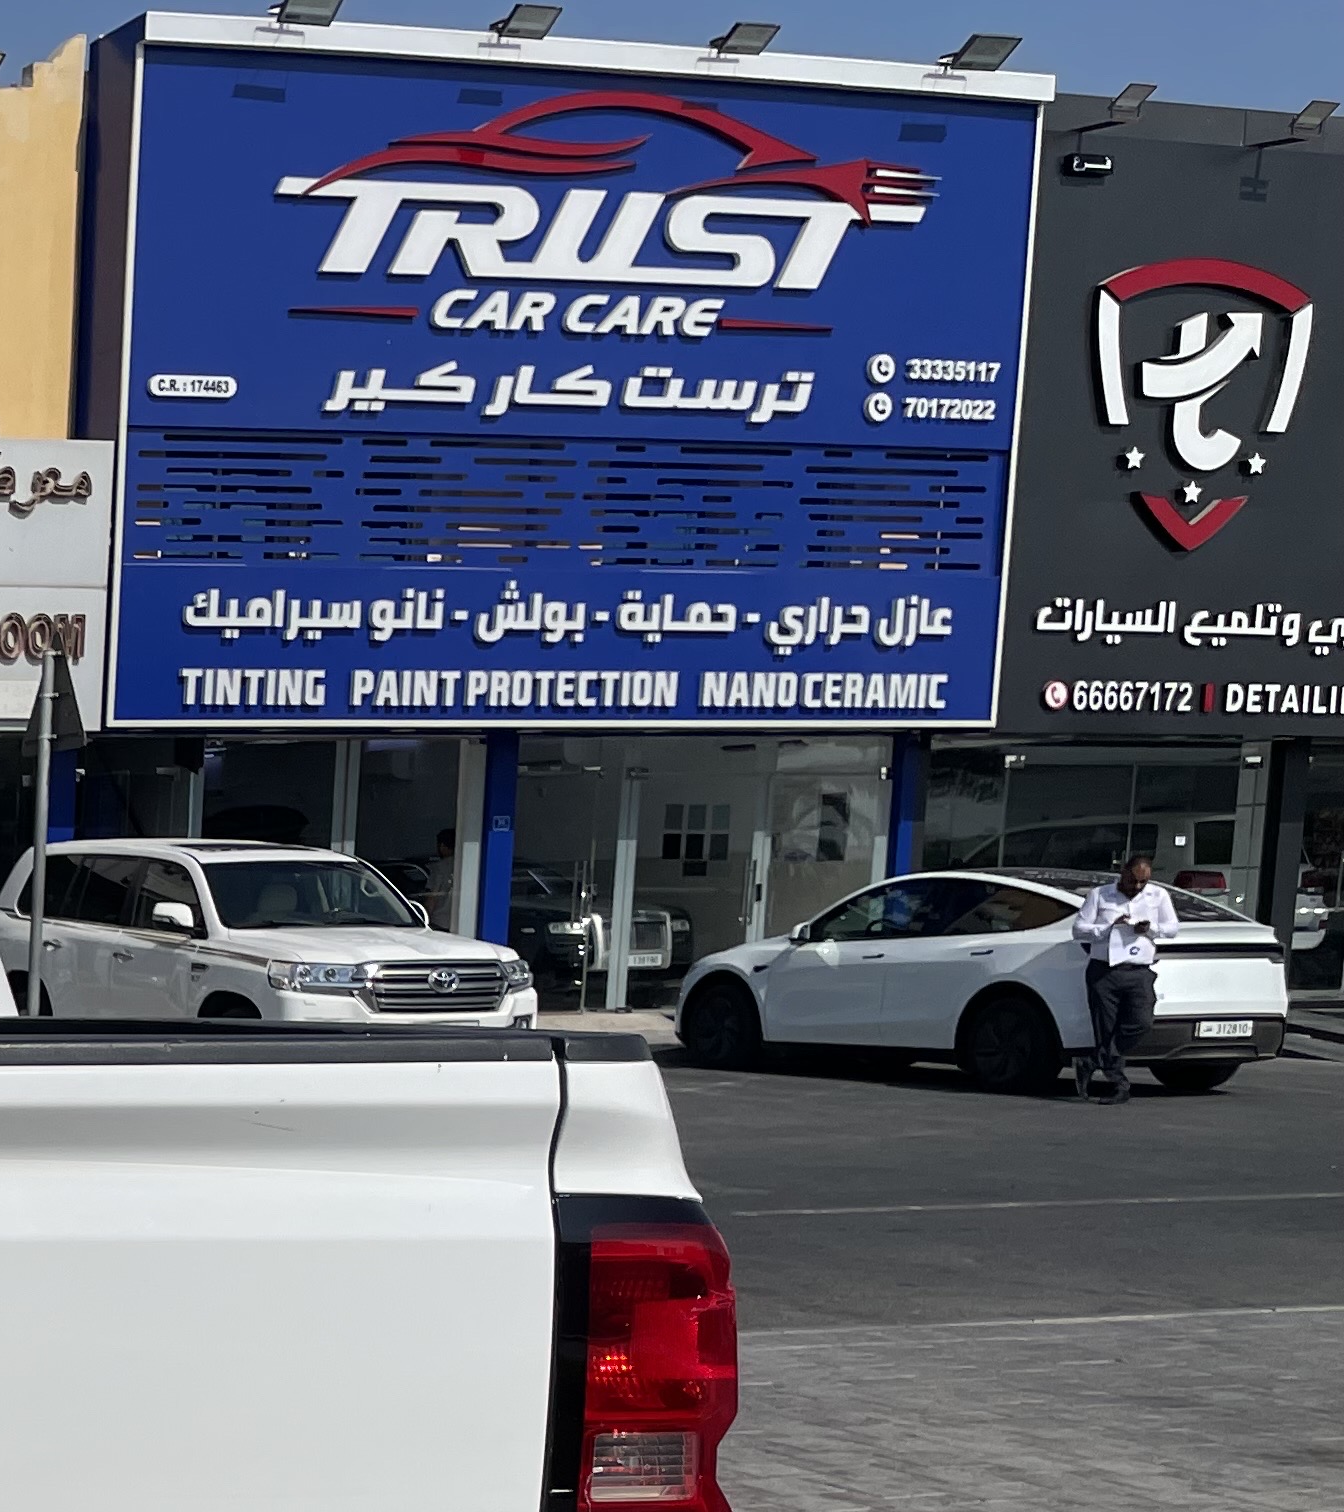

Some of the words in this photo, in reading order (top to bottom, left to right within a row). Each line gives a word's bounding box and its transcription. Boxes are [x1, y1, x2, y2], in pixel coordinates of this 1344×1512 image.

[274, 175, 926, 291] TRUST
[433, 289, 557, 331] CAR
[564, 294, 726, 337] CARE
[323, 360, 476, 411] كير
[484, 364, 612, 416] كار
[623, 366, 815, 423] ترست
[905, 358, 1001, 383] 33335117
[905, 397, 996, 421] 70172022
[185, 588, 362, 641] سيراميك
[371, 587, 445, 642] نانو
[477, 580, 586, 643] بولش
[618, 590, 737, 643] حماية
[768, 596, 870, 656] حراري
[878, 594, 952, 647] عازل
[1036, 597, 1177, 645] السيارات
[1183, 603, 1302, 647] وتلميع
[181, 667, 326, 706] TINTING
[352, 669, 462, 707] PAINT
[466, 670, 679, 707] PROTECTION
[701, 670, 798, 709] NANO
[802, 672, 949, 709] CERAMIC
[1073, 680, 1193, 712] 66667172
